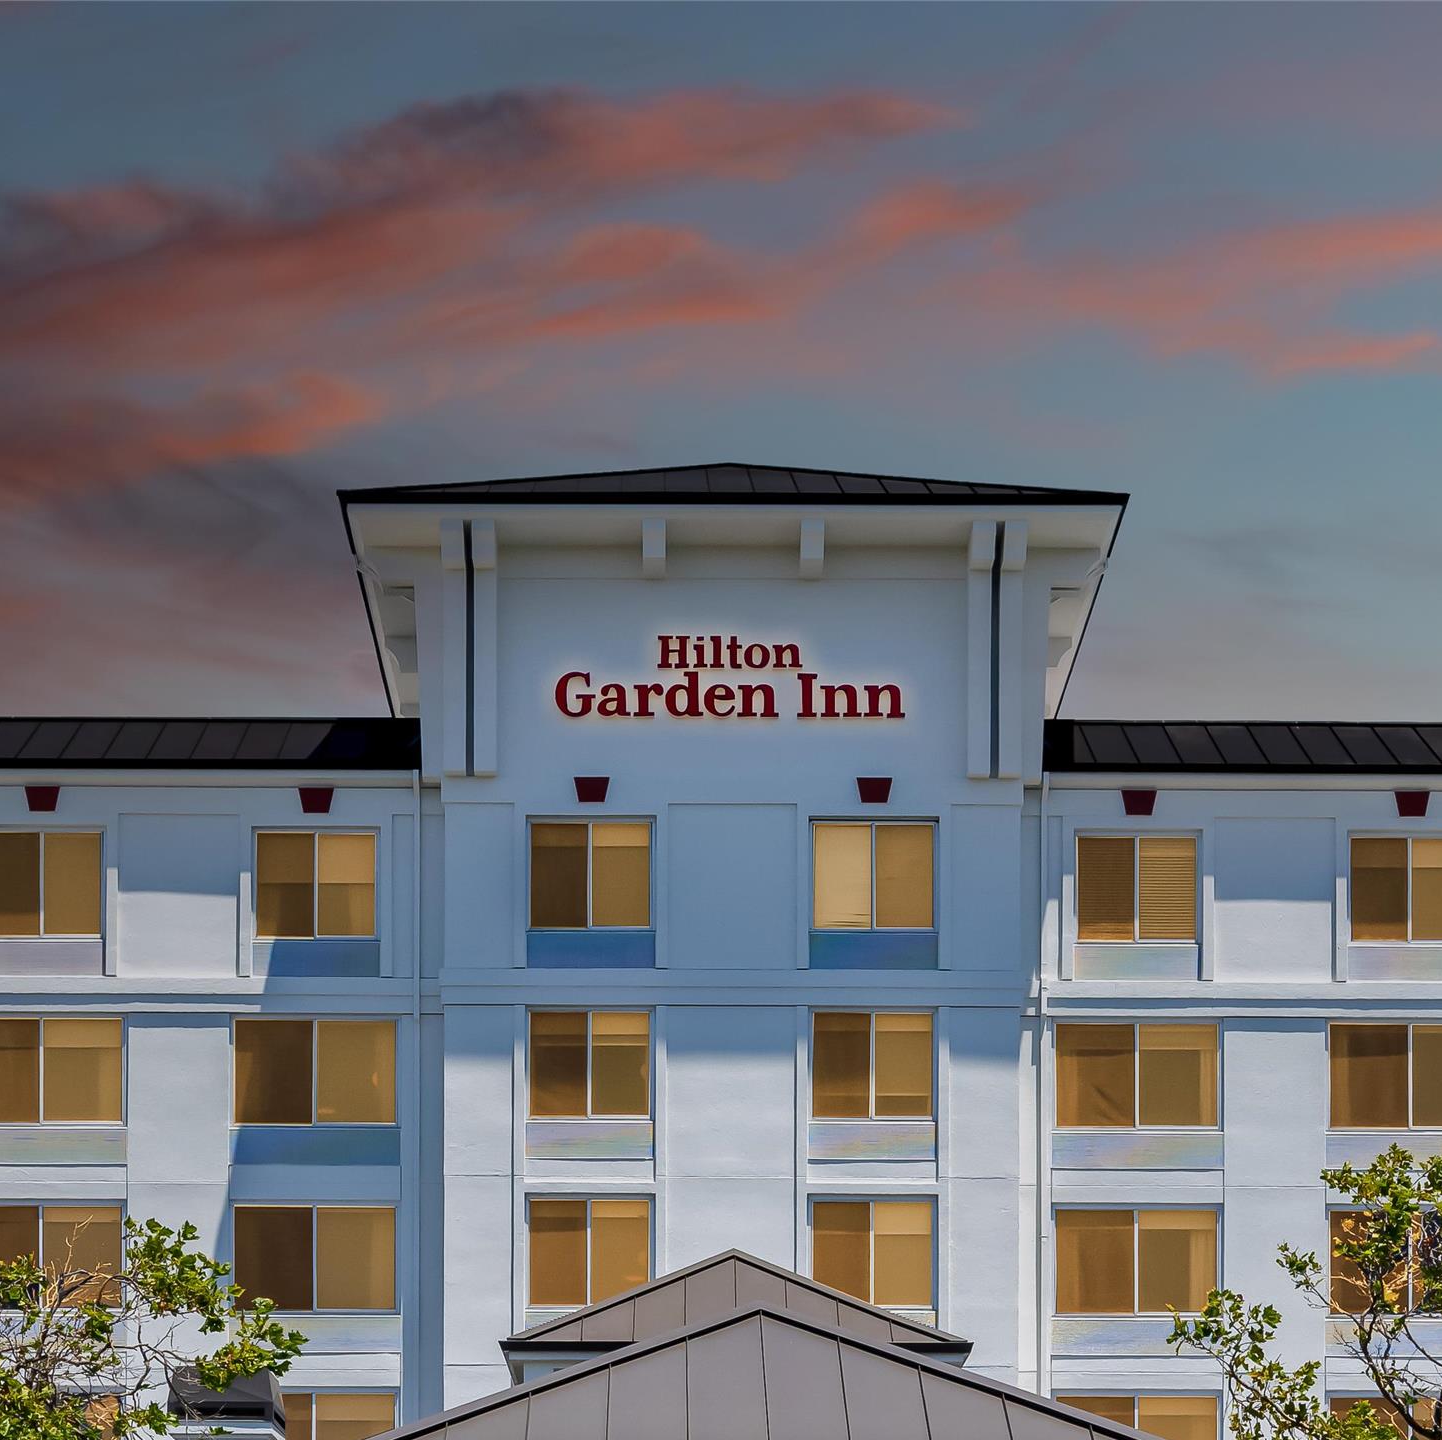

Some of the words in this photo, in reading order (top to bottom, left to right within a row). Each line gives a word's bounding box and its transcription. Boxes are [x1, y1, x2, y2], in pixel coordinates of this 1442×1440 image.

[657, 635, 803, 669] Hilton
[555, 671, 780, 718] Garden
[797, 672, 906, 719] Inn
